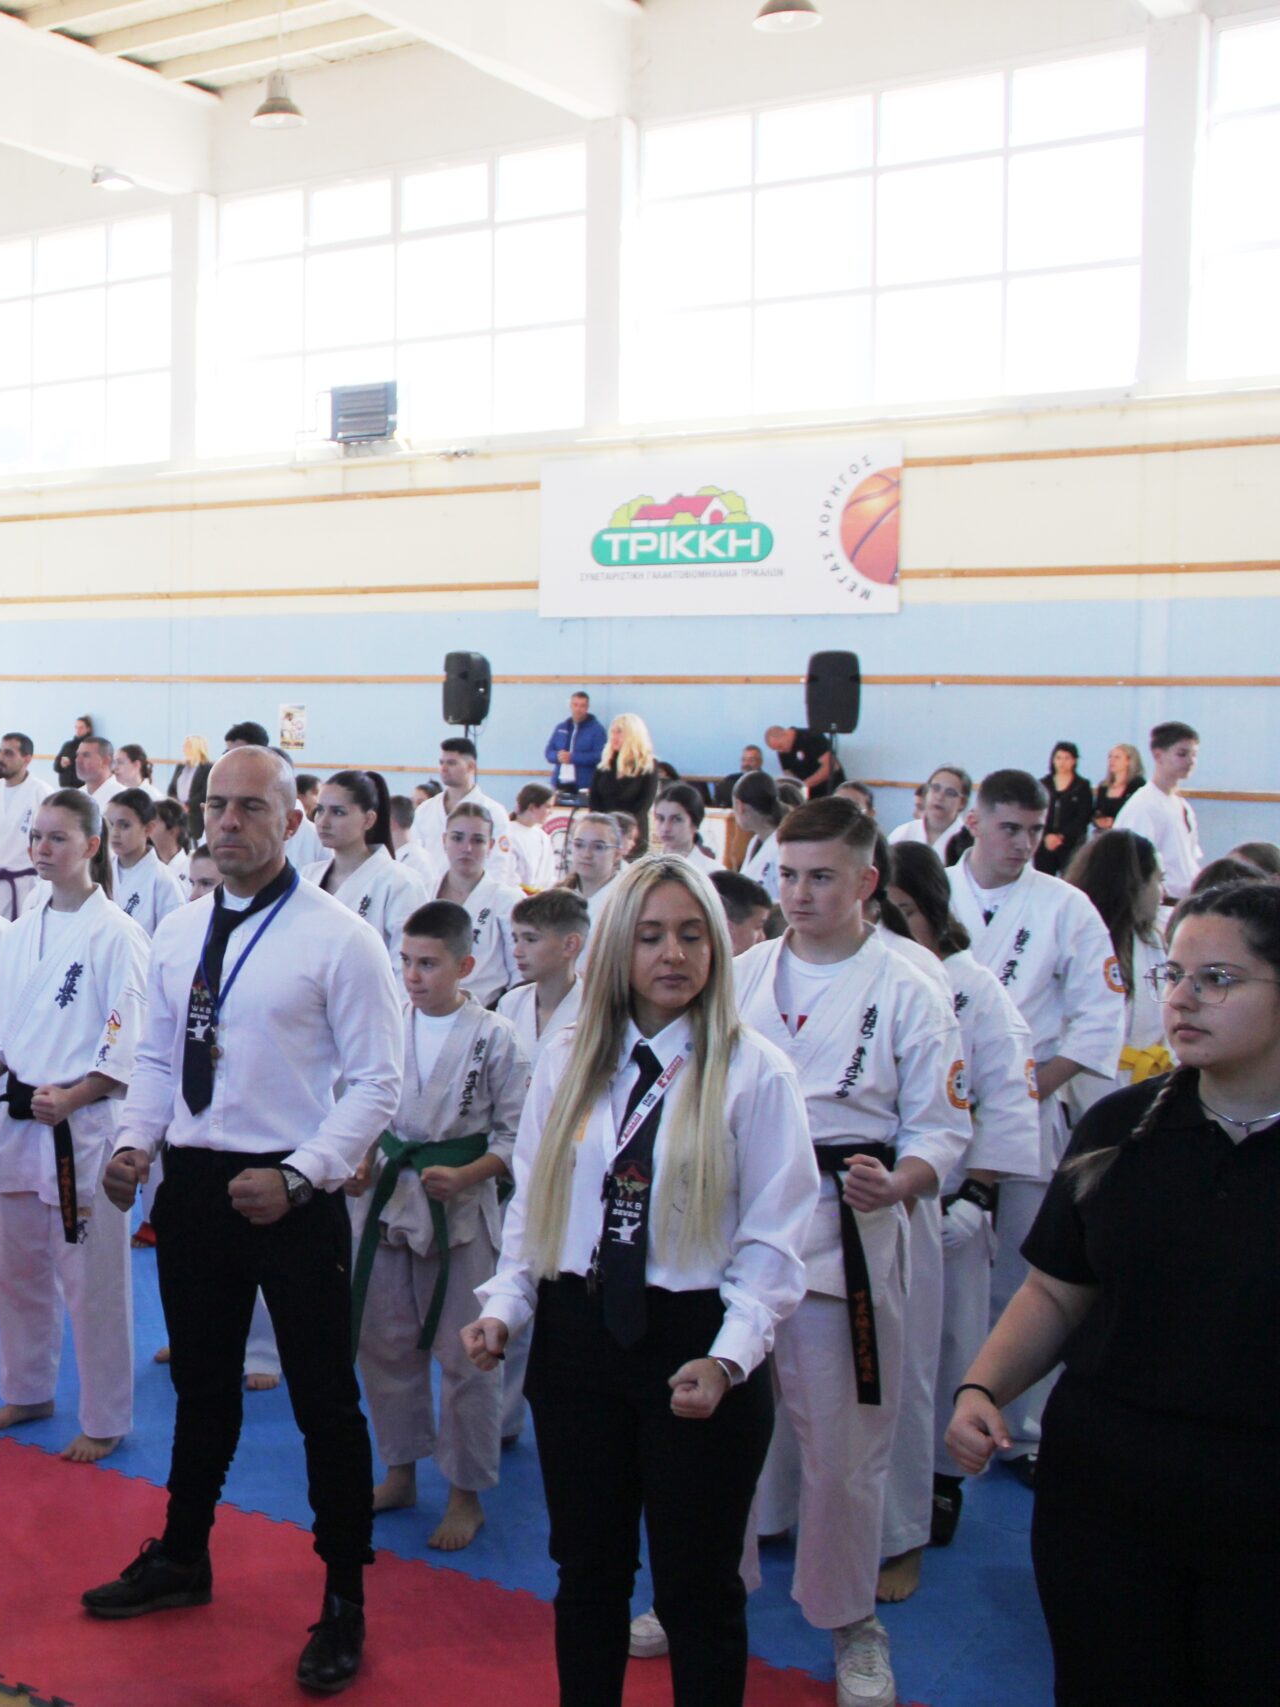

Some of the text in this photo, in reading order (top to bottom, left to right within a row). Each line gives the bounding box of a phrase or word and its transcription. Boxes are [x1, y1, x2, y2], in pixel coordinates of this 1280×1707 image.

[601, 527, 761, 562] ΤΡΙΚΚΗ
[614, 1199, 643, 1211] WKB
[612, 1208, 641, 1218] SEVEN
